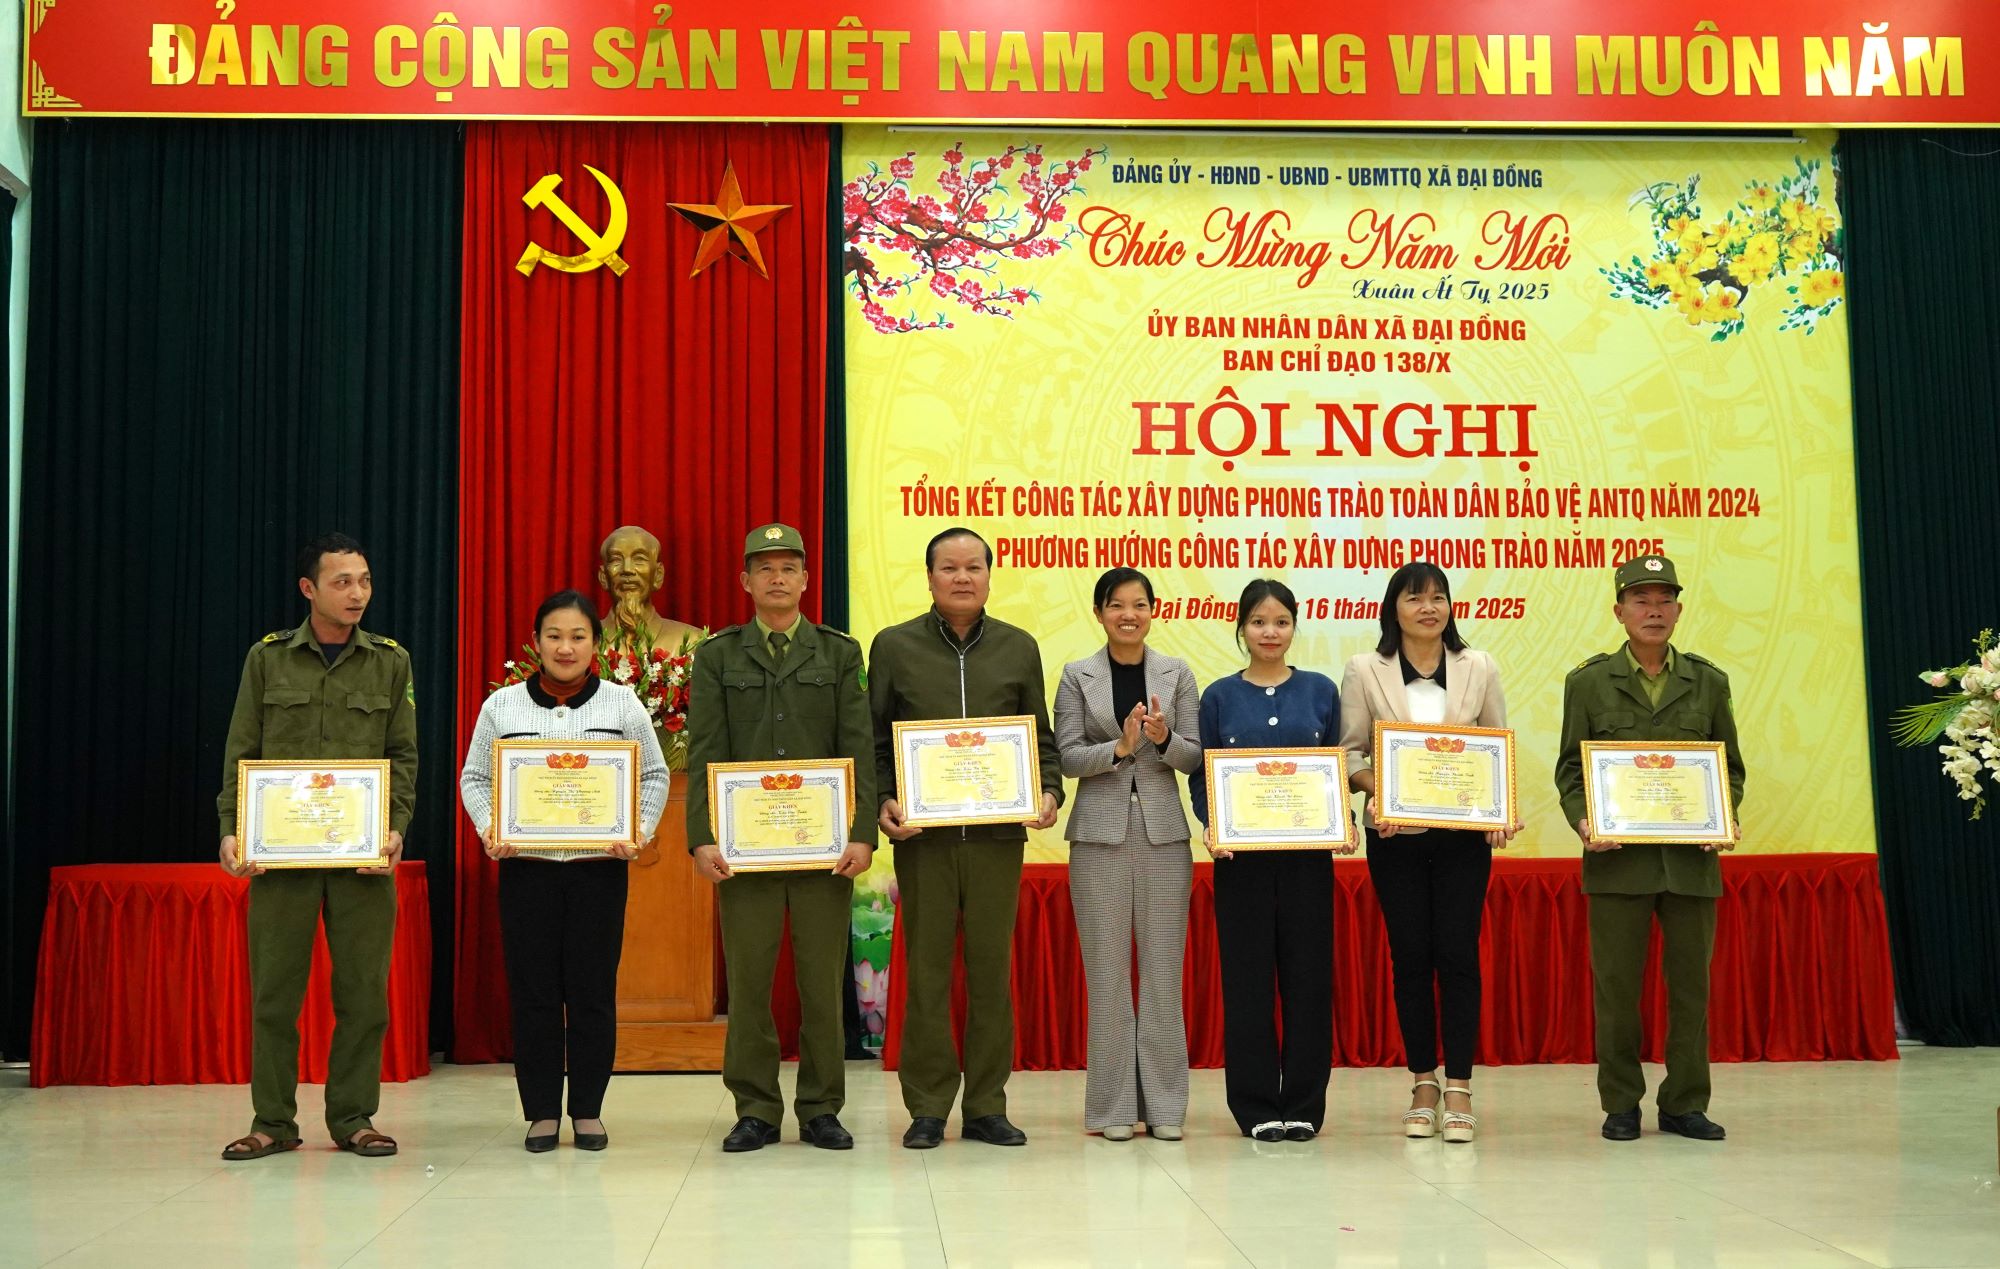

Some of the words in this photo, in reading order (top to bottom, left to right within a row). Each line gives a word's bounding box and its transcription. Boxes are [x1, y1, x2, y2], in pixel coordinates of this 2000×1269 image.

[148, 0, 349, 87] ĐẢNG
[373, 10, 569, 103] CỘNG
[591, 3, 737, 90] SẢN
[760, 15, 911, 105] VIỆT
[938, 29, 1104, 93] NAM
[1127, 31, 1367, 100] QUANG
[1388, 33, 1553, 96] VINH
[1574, 20, 1781, 97] MUÔN
[1803, 21, 1965, 97] NĂM
[1112, 157, 1163, 184] ĐẢNG
[1169, 157, 1192, 184] ỦY
[1210, 165, 1261, 185] HĐND
[1279, 166, 1329, 186] UBND
[1348, 167, 1422, 189] UBMTTQ
[1427, 167, 1452, 187] XÃ
[1456, 168, 1487, 191] ĐẠI
[1492, 165, 1543, 188] ĐỒNG
[1077, 205, 1187, 268] Chúc
[1195, 206, 1332, 289] Mừng
[1340, 208, 1457, 270] Năm
[1473, 209, 1572, 272] Mới
[1352, 278, 1416, 300] Xuân
[1497, 282, 1550, 300] 2025
[1147, 308, 1179, 337] ỦY
[1185, 315, 1236, 339] BAN
[1242, 313, 1311, 340] NHÂN
[1317, 315, 1368, 340] DÂN
[1374, 315, 1407, 340] XÃ
[1412, 319, 1454, 345] ĐẠI
[1459, 315, 1527, 342] ĐỒNG
[1223, 349, 1274, 372] BAN
[1280, 343, 1321, 372] CHỈ
[1327, 350, 1376, 377] ĐẠO
[1383, 351, 1451, 374] 138/X
[1131, 385, 1292, 473] HỘI
[1315, 402, 1539, 473] NGHỊ
[899, 473, 960, 517] TỔNG
[965, 479, 1007, 517] KẾT
[1012, 480, 1075, 518] CÔNG
[1079, 479, 1123, 518] TÁC
[1127, 480, 1172, 517] XÂY
[1177, 484, 1240, 523] DỰNG
[1245, 486, 1322, 518] PHONG
[1327, 480, 1385, 519] TRÀO
[1389, 481, 1449, 519] TOÀN
[1453, 481, 1500, 519] DÂN
[1505, 477, 1550, 519] BẢO
[1555, 482, 1583, 525] VỆ
[1587, 487, 1646, 522] ANTQ
[1649, 482, 1702, 518] NĂM
[1707, 487, 1761, 518] 2024
[996, 534, 1089, 569] PHƯƠNG
[1094, 529, 1172, 570] HƯỚNG
[1177, 531, 1240, 569] CÔNG
[1244, 531, 1288, 570] TÁC
[1293, 532, 1337, 569] XÂY
[1342, 535, 1405, 575] DỰNG
[1409, 538, 1487, 570] PHONG
[1490, 531, 1549, 570] TRÀO
[1553, 531, 1606, 569] NĂM
[1306, 597, 1329, 621] 16
[1473, 597, 1526, 620] 2025
